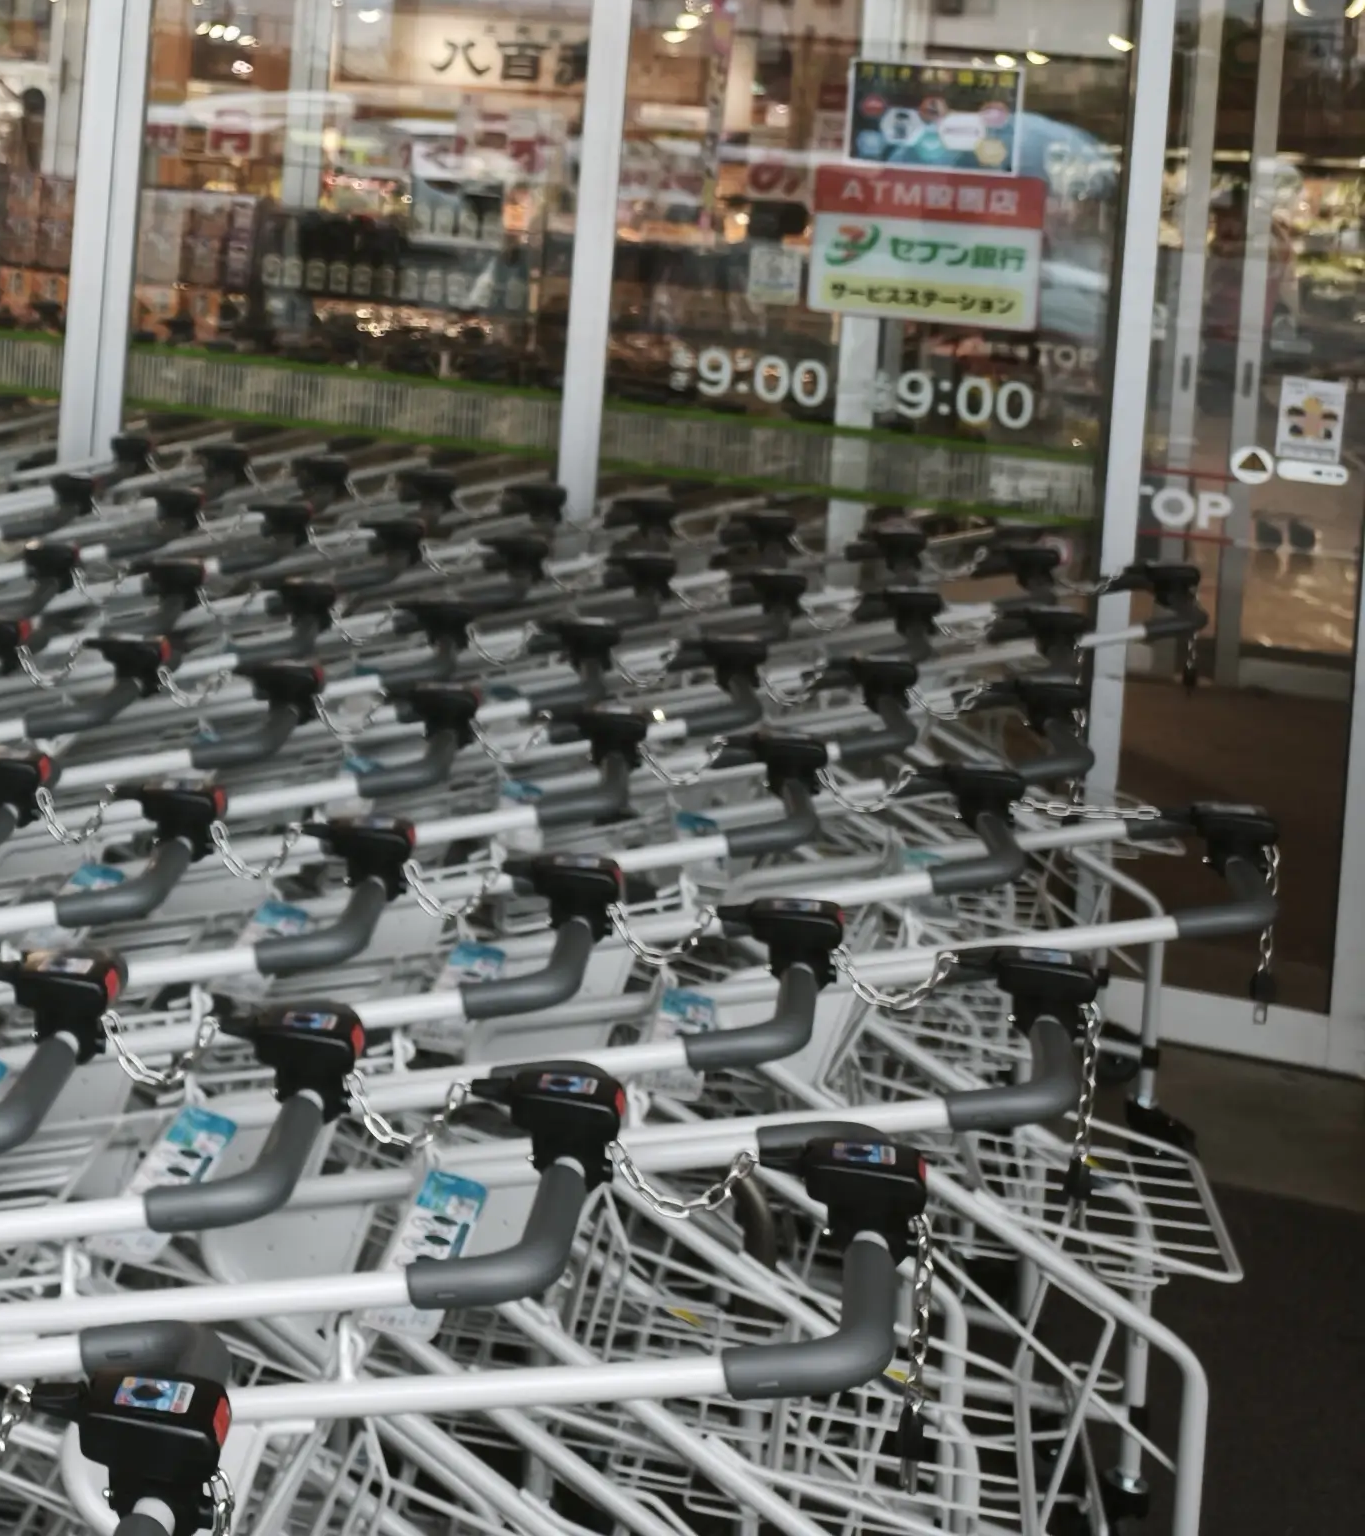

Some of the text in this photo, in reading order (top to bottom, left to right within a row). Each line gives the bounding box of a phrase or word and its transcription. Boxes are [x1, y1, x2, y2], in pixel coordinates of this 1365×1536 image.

[889, 237, 1025, 272] セブン銀行
[830, 282, 1015, 314] サービスステーション
[697, 348, 829, 408] 9:00
[896, 370, 1035, 430] 9:00
[1139, 485, 1233, 529] OP
